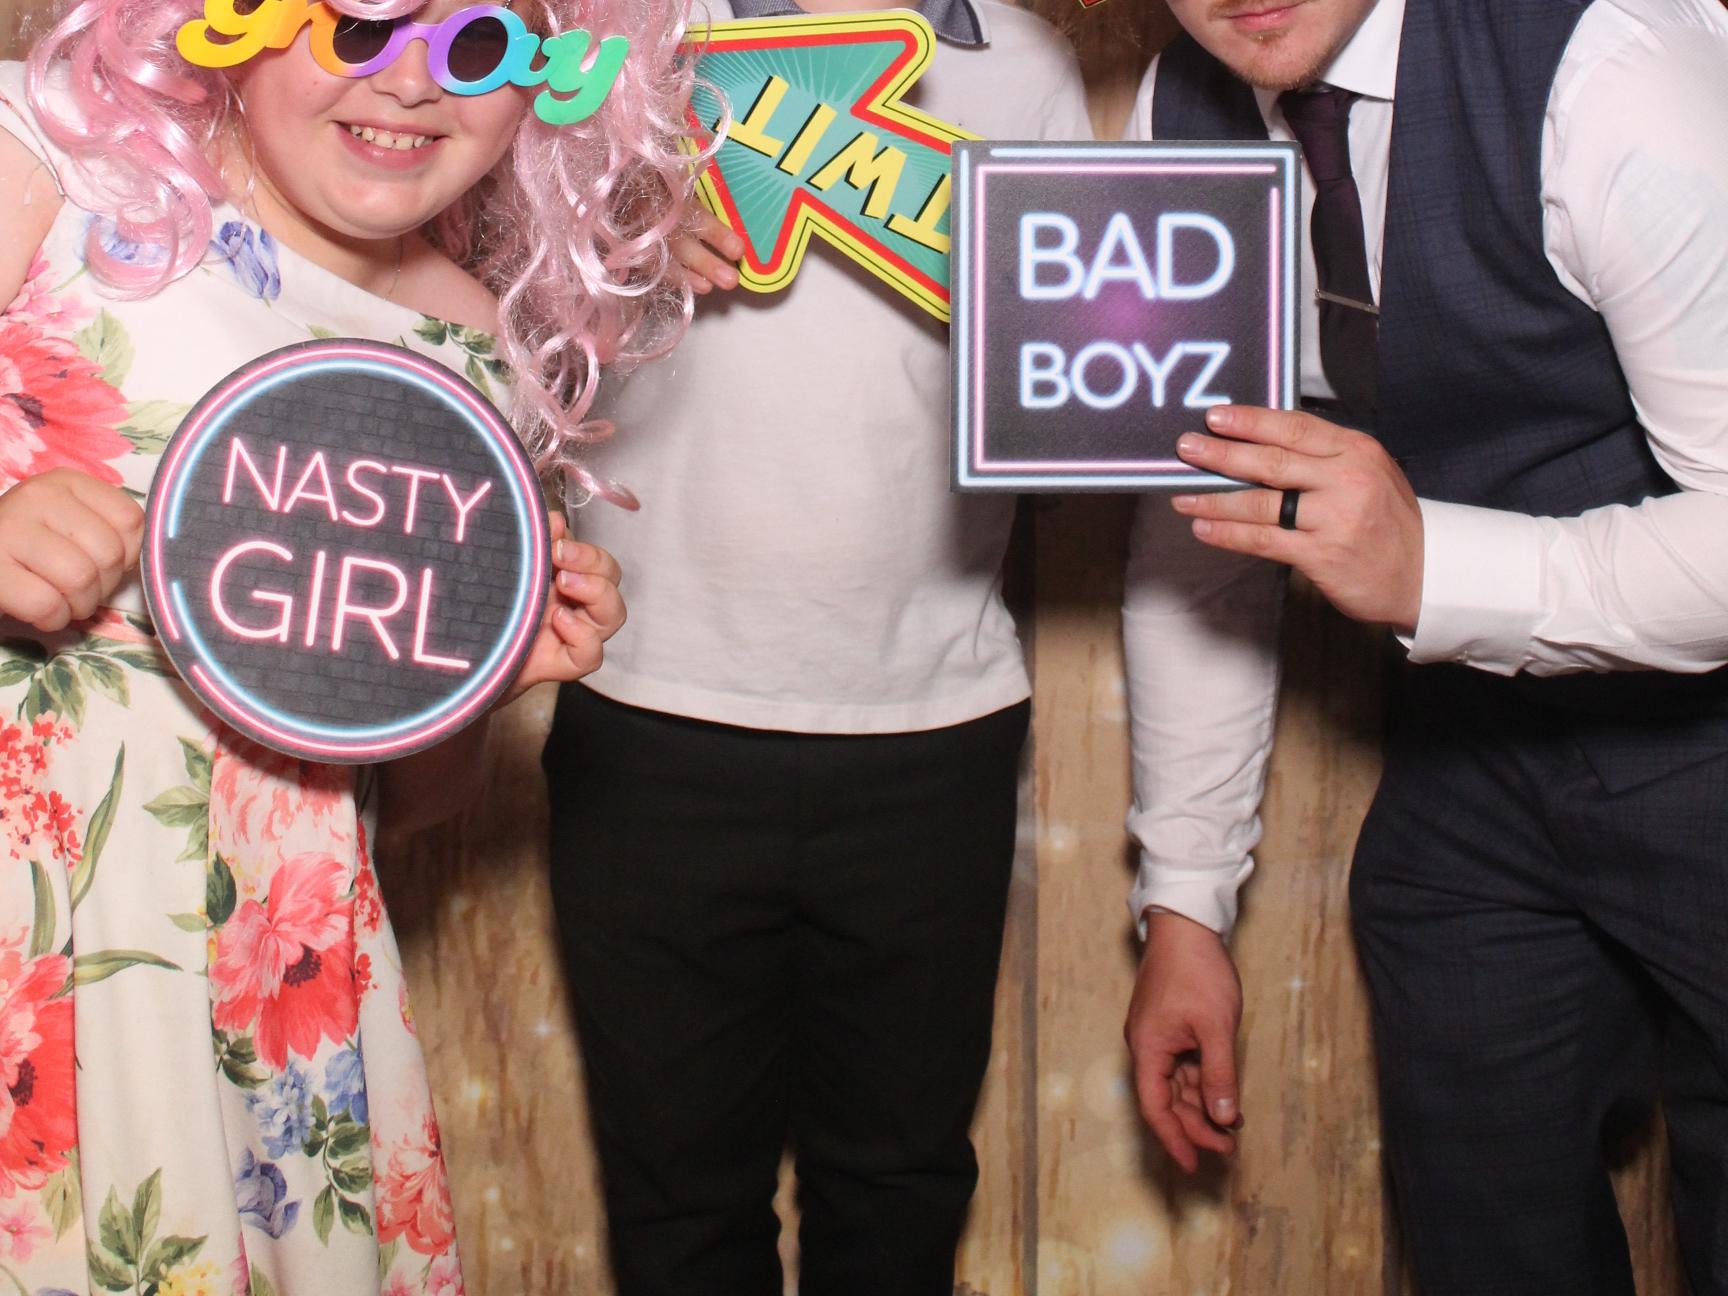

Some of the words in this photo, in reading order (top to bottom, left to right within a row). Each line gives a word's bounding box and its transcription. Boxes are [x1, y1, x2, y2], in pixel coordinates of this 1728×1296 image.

[713, 75, 951, 253] TWIT
[1019, 211, 1235, 299] BAD
[1019, 341, 1232, 409] BOYZ
[222, 437, 492, 543] NASTY
[209, 540, 470, 669] GIRL
